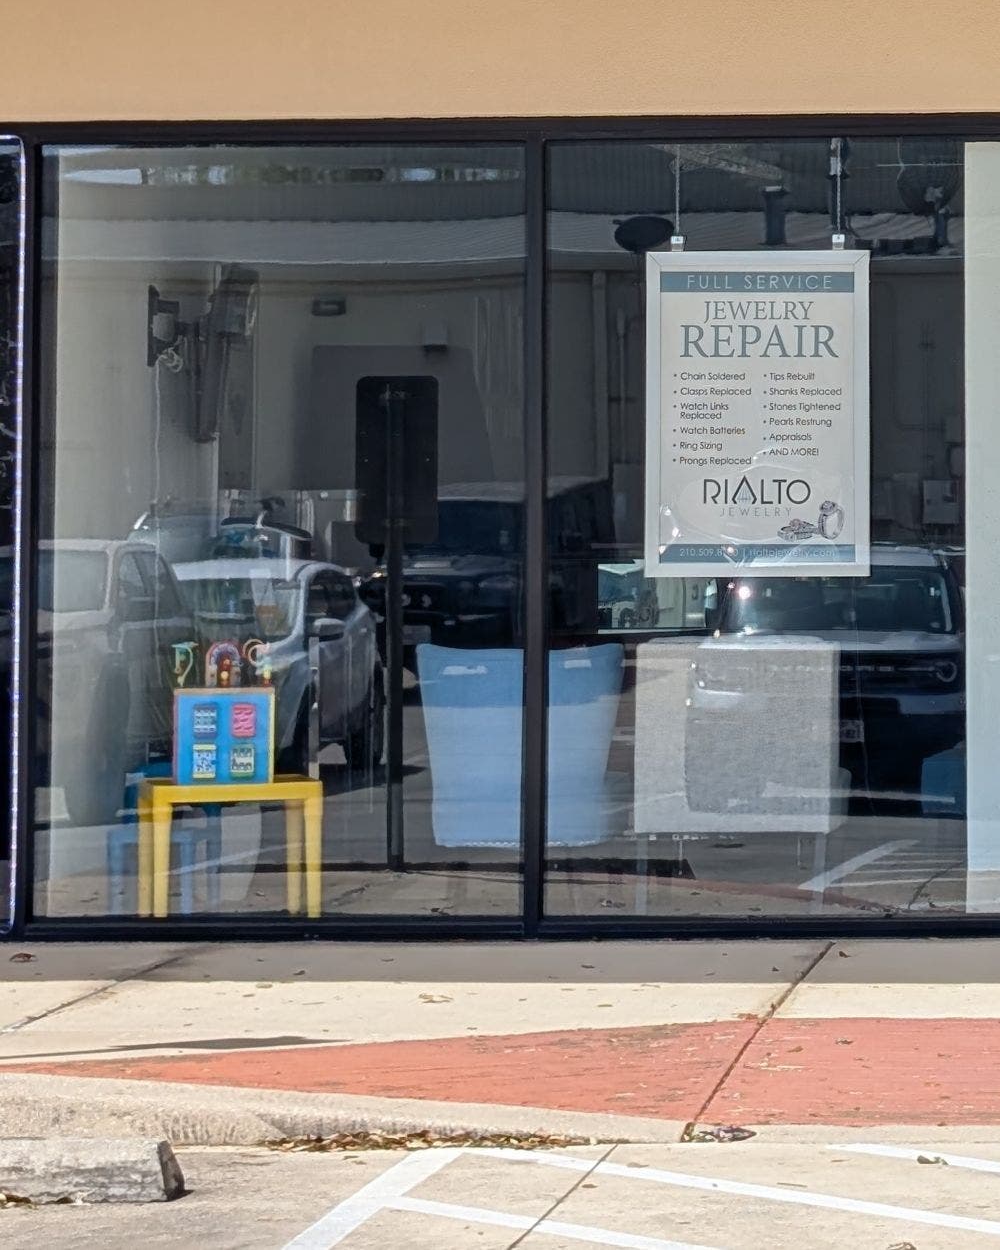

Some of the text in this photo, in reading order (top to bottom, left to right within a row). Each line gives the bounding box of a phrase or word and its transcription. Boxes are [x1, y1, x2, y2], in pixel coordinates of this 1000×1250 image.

[686, 273, 834, 291] FULL SERVICE
[702, 300, 815, 324] JEWELRY
[679, 323, 840, 359] REPAIR
[680, 372, 746, 381] Chain Soldered
[769, 372, 815, 382] Tips Rebuilt
[680, 387, 752, 397] Clasps Replaced
[769, 387, 842, 397] Shanks Replaced
[680, 402, 729, 411] Watch Links
[769, 402, 841, 413] Stones Tightened
[680, 411, 722, 420] Replaced
[769, 417, 832, 427] Pearls Restrung
[680, 426, 746, 435] Watch Batteries
[769, 433, 812, 442] Appraisals
[679, 441, 723, 451] Ring Sizing
[768, 447, 819, 456] AND MORE!
[679, 456, 752, 467] Prongs Replaced
[702, 474, 812, 505] RIALTO
[719, 507, 793, 518] JEWELRY
[679, 548, 739, 557] 210.509.80
